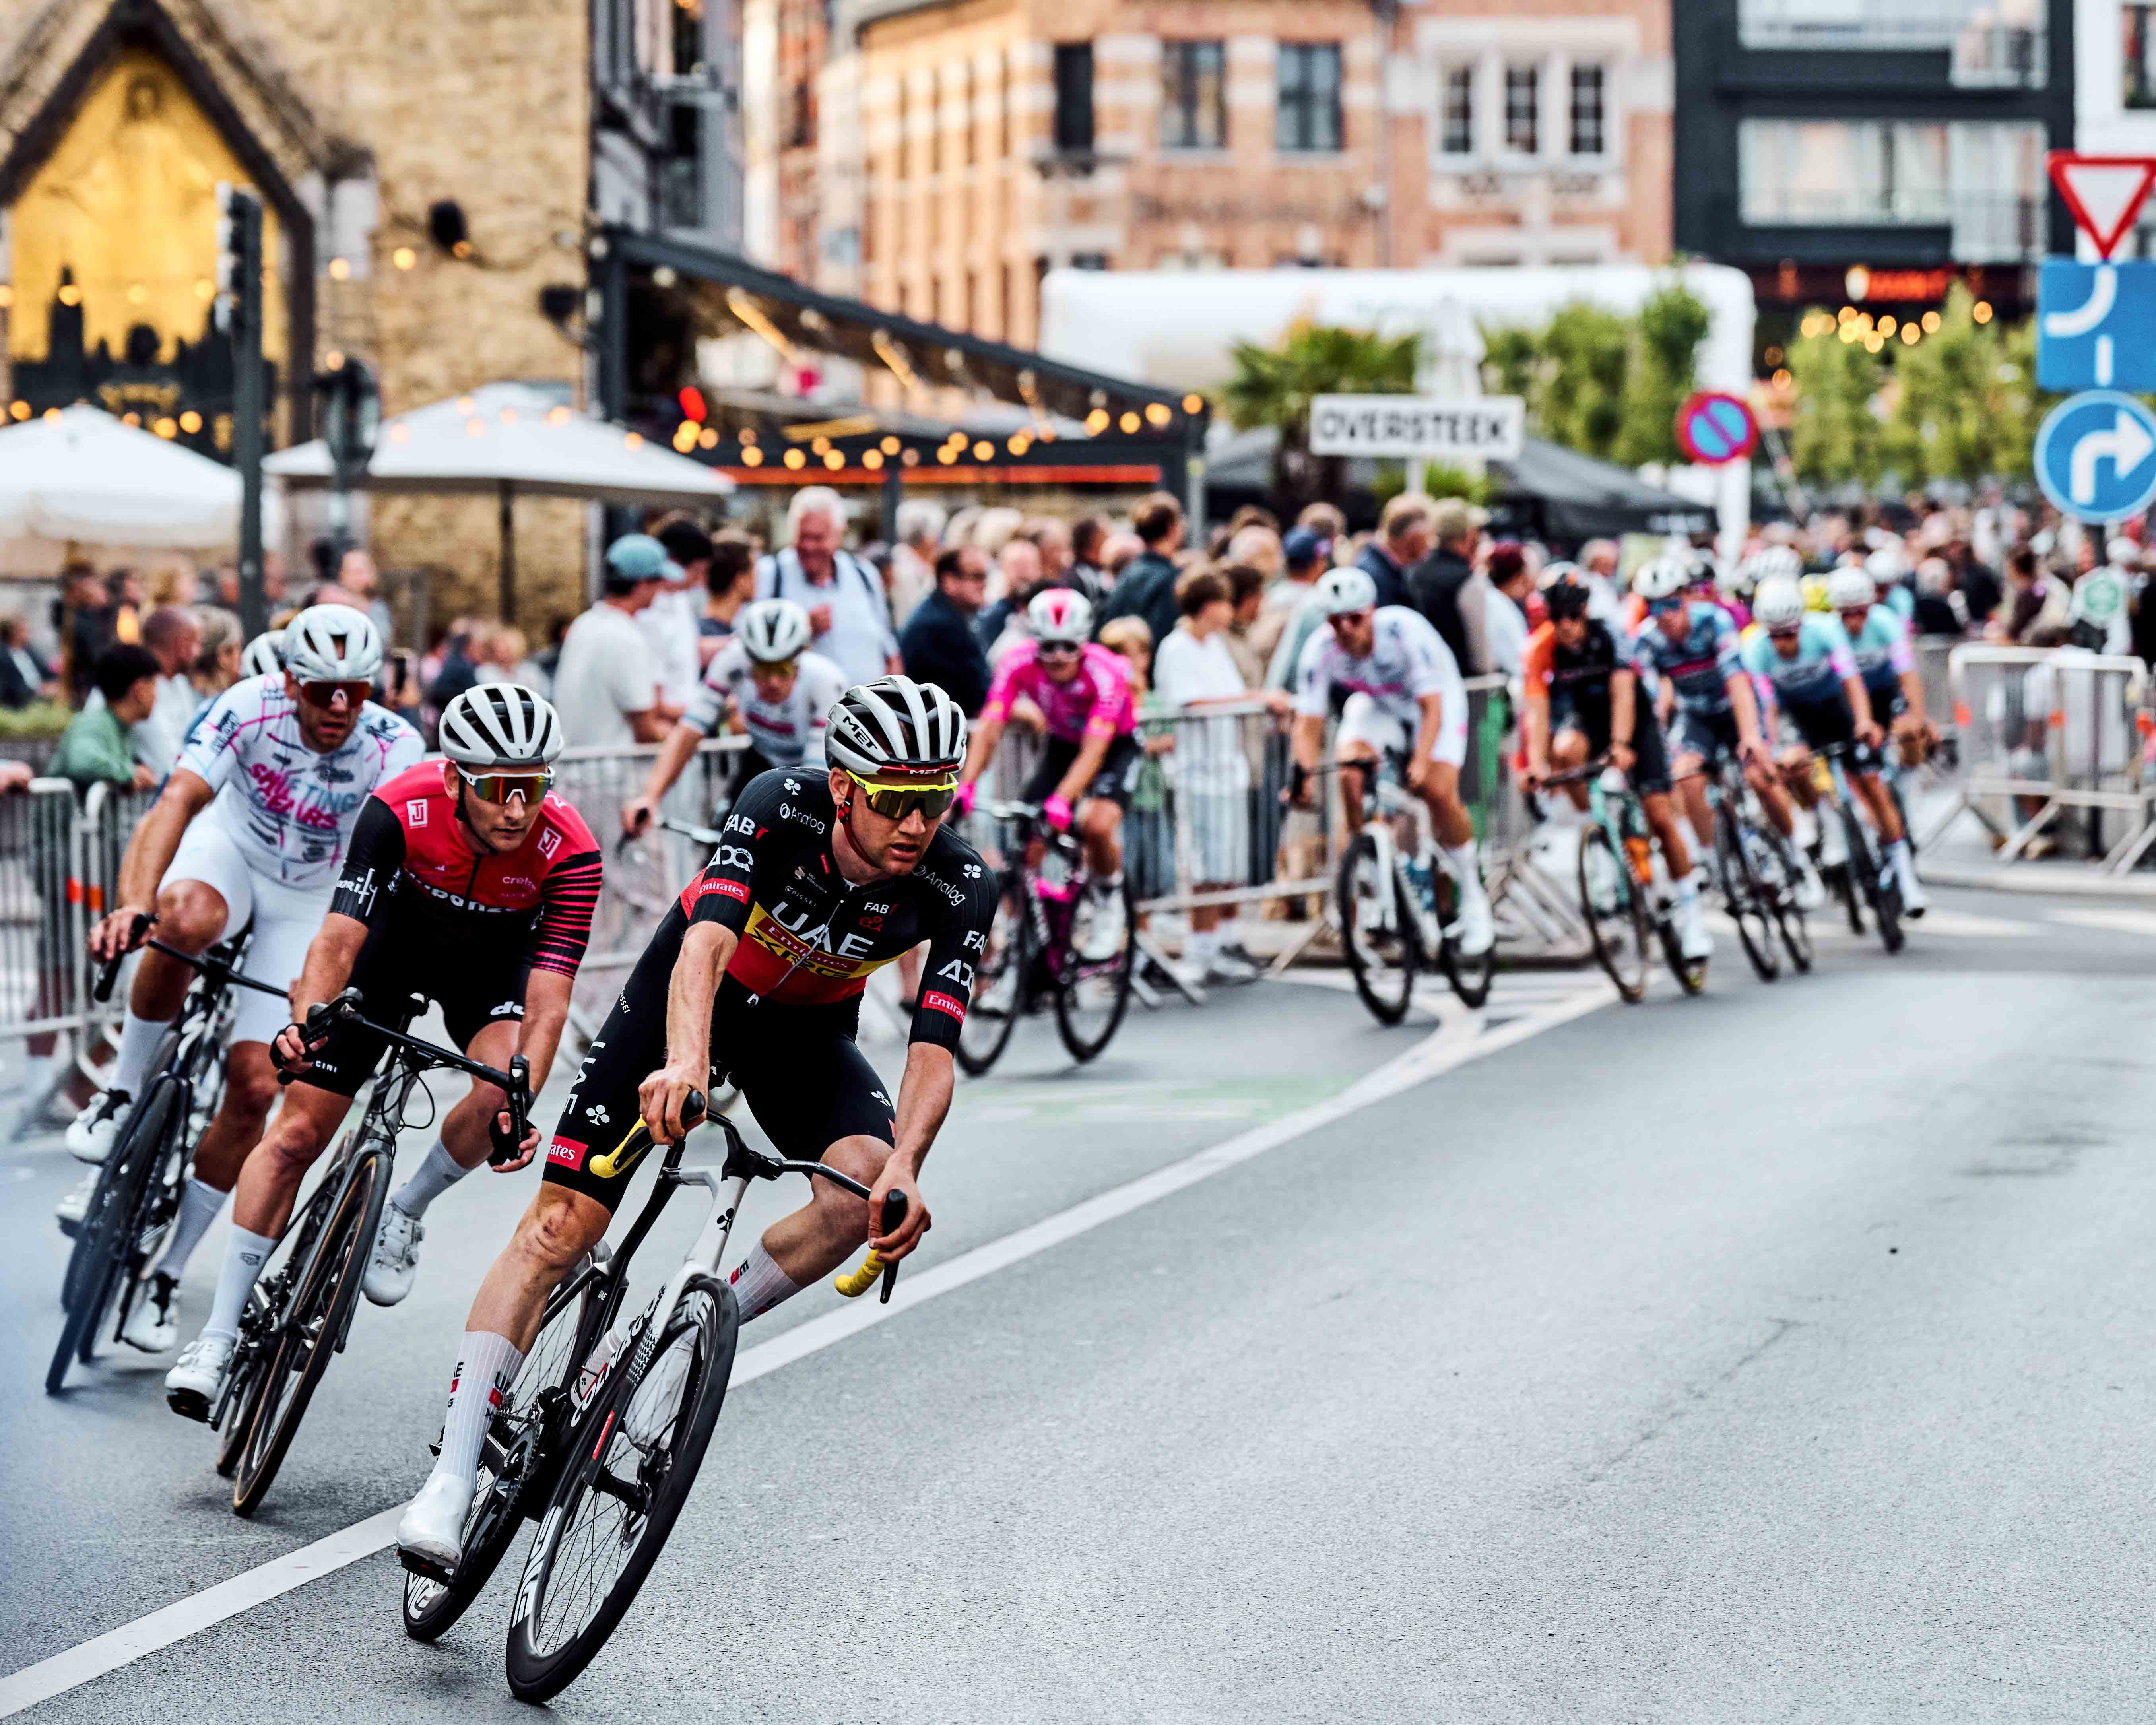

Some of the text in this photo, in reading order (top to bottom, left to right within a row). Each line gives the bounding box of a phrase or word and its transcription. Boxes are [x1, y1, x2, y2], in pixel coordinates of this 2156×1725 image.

[1321, 409, 1507, 444] OVERSTEEK
[842, 715, 877, 750] MET
[925, 871, 966, 906] Analog
[864, 902, 889, 914] FAB
[772, 901, 875, 960] UAE
[963, 930, 988, 956] FA
[937, 959, 974, 993] AD
